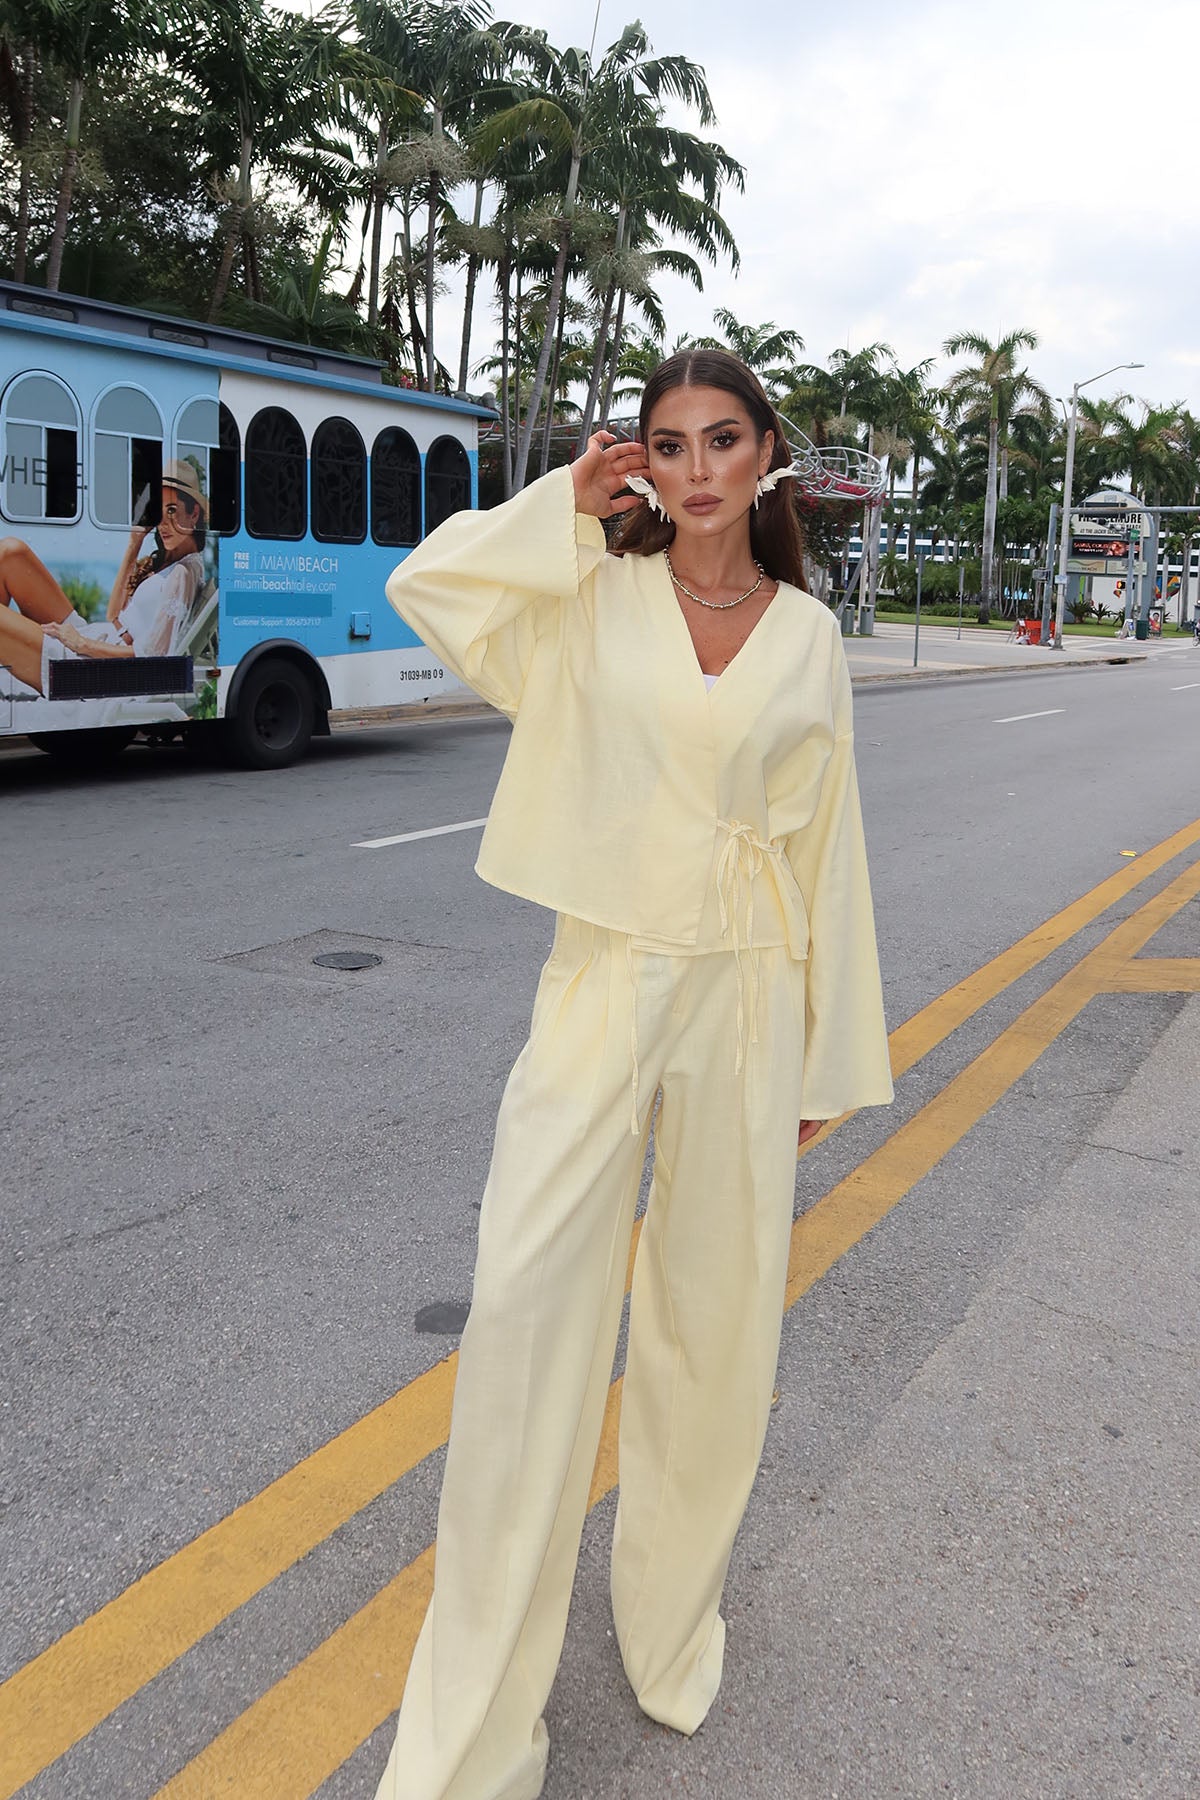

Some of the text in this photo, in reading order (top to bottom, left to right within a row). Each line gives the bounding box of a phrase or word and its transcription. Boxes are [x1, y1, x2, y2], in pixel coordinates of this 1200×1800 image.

[0, 455, 88, 490] HE.
[234, 552, 250, 560] FREE
[234, 561, 249, 569] RIDE
[234, 576, 336, 592] miamibeachtroley.com
[233, 617, 259, 626] Customer
